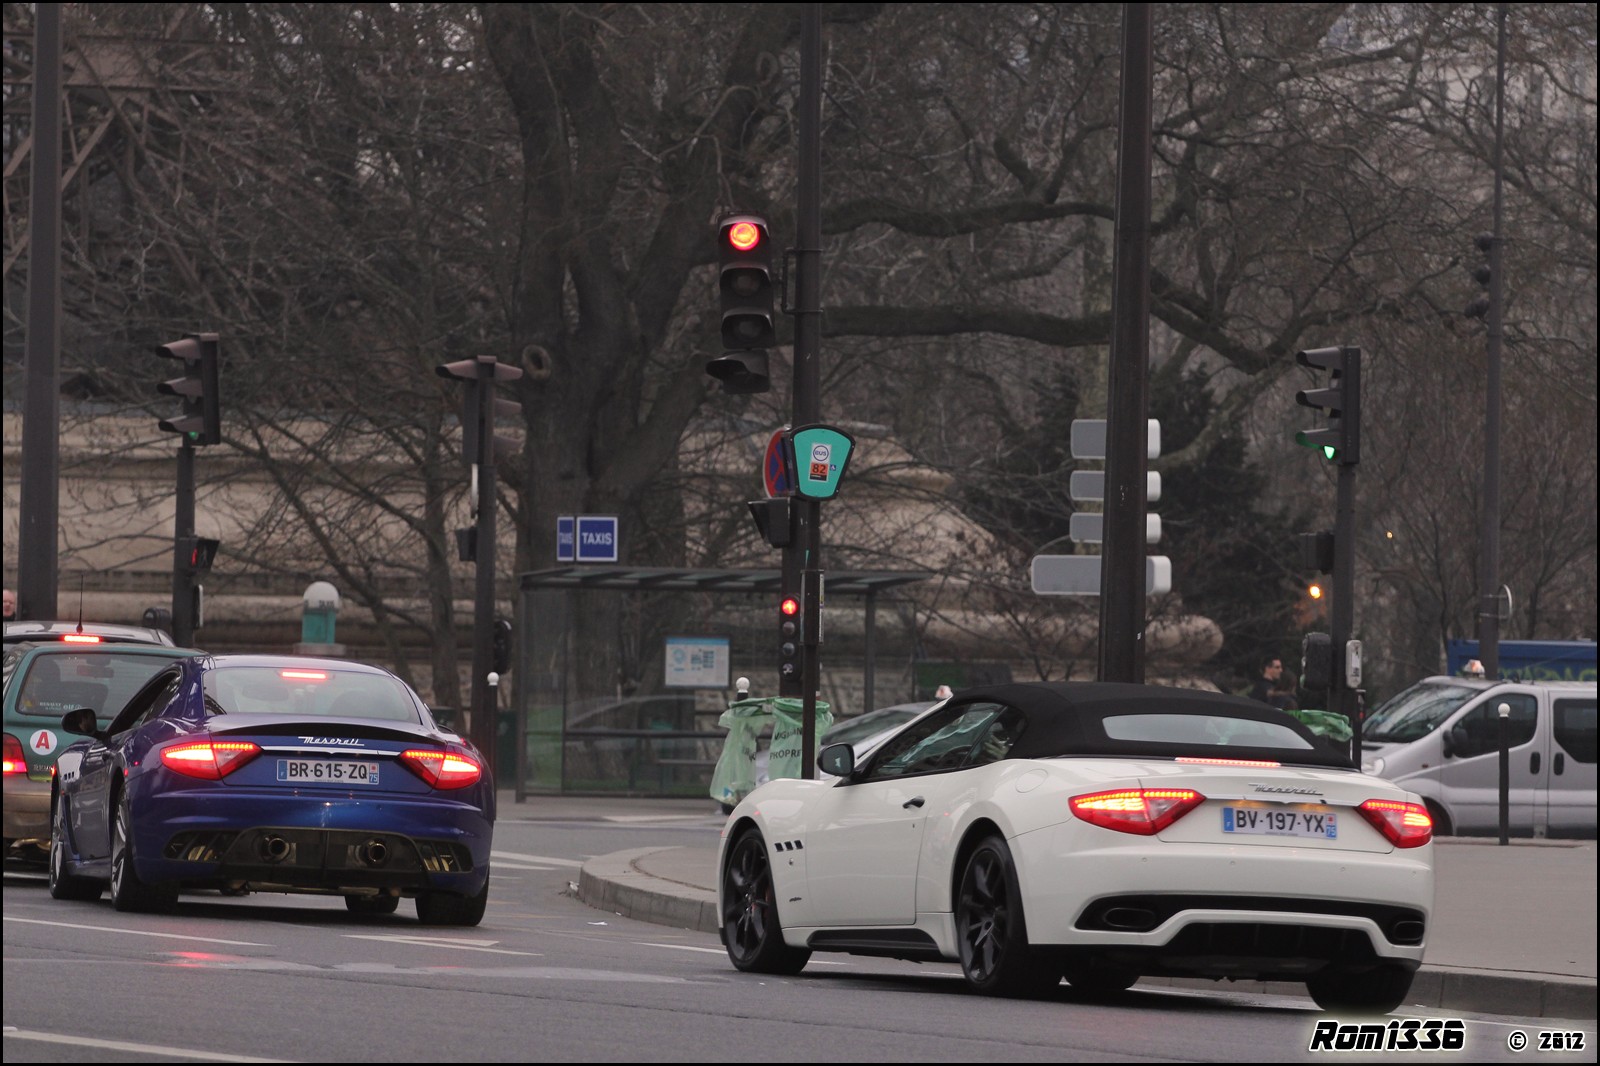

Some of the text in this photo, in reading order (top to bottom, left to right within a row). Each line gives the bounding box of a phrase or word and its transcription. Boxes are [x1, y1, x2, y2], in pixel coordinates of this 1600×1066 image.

[812, 464, 826, 474] 82
[582, 532, 612, 545] TAXIS
[36, 731, 50, 749] A
[298, 736, 364, 746] Maserati
[370, 774, 378, 782] 75
[1248, 782, 1323, 795] Maserati
[1326, 826, 1336, 837] 75
